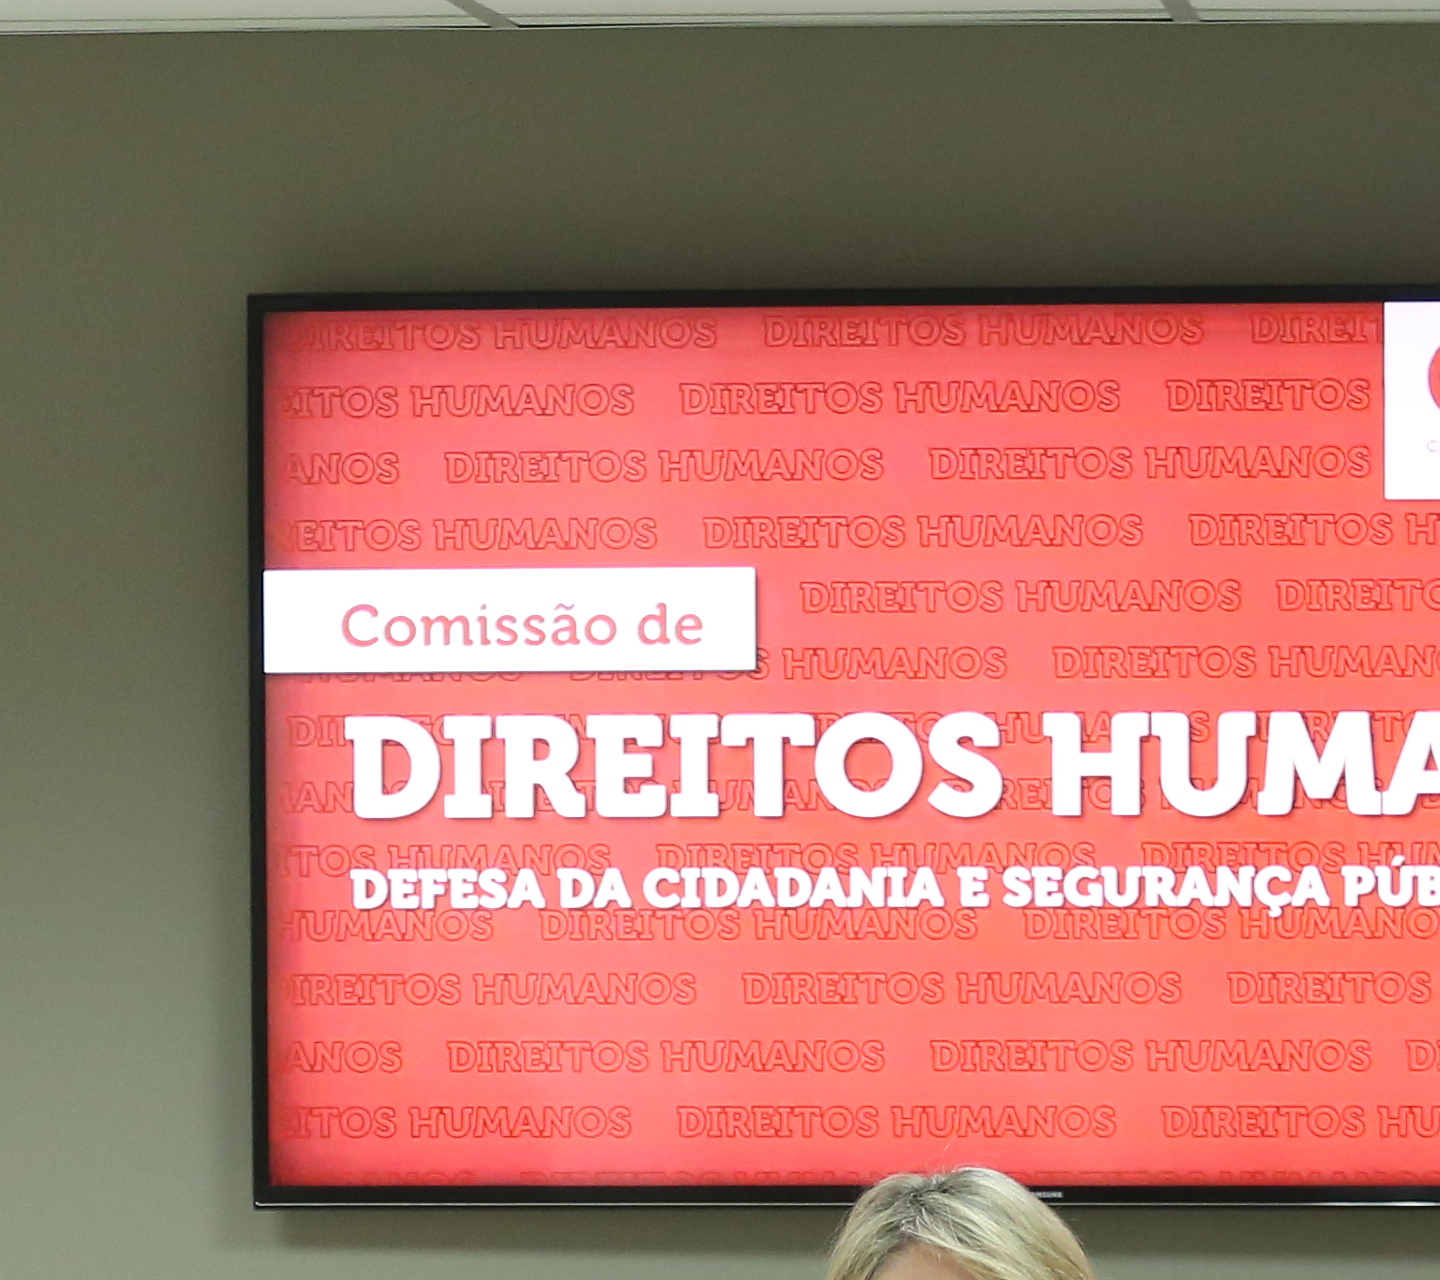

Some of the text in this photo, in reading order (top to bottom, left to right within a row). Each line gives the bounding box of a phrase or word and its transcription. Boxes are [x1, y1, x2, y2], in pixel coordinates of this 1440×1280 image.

[494, 317, 718, 350] HUMANOS
[762, 314, 967, 348] DIREITOS
[977, 312, 1204, 346] HUMANOS
[283, 378, 1370, 419] ITOS HUMANOS DIREITOS HUMANOS DIREITOS
[444, 449, 647, 484] DIREITOS
[658, 448, 885, 482] HUMANOS
[928, 445, 1134, 480] DIREITOS
[1144, 444, 1371, 478] HUMANOS
[433, 517, 658, 550] HUMANOS
[701, 514, 906, 549] DIREITOS
[916, 512, 1144, 547] HUMANOS
[1188, 511, 1394, 546] DIREITOS
[799, 579, 1005, 613] DIREITOS
[1014, 578, 1243, 613] HUMANOS
[340, 601, 705, 648] Comissão de
[781, 646, 1009, 680] HUMANOS
[1051, 645, 1257, 679] DIREITOS
[344, 711, 1003, 820] DIREITOS
[387, 843, 613, 875] HUMANOS
[349, 867, 546, 911] DEFESA
[556, 866, 633, 910] DA
[641, 864, 945, 910] CIDADANIA
[957, 864, 990, 908] E
[1002, 864, 1331, 919] SEGURANÇA
[536, 910, 741, 942] DIREITOS
[752, 909, 979, 941] HUMANOS
[1023, 909, 1227, 941] DIREITOS
[472, 972, 698, 1006] HUMANOS
[741, 971, 945, 1006] DIREITOS
[955, 971, 1184, 1005] HUMANOS
[1226, 970, 1433, 1005] DIREITOS
[446, 1040, 650, 1074] DIREITOS
[660, 1039, 886, 1073] HUMANOS
[929, 1039, 1134, 1073] DIREITOS
[1144, 1038, 1373, 1073] HUMANOS
[284, 1106, 398, 1140] ITOS
[408, 1105, 633, 1139] HUMANOS
[675, 1105, 880, 1139] DIREITOS
[890, 1104, 1118, 1139] HUMANOS
[1160, 1104, 1366, 1139] DIREITOS
